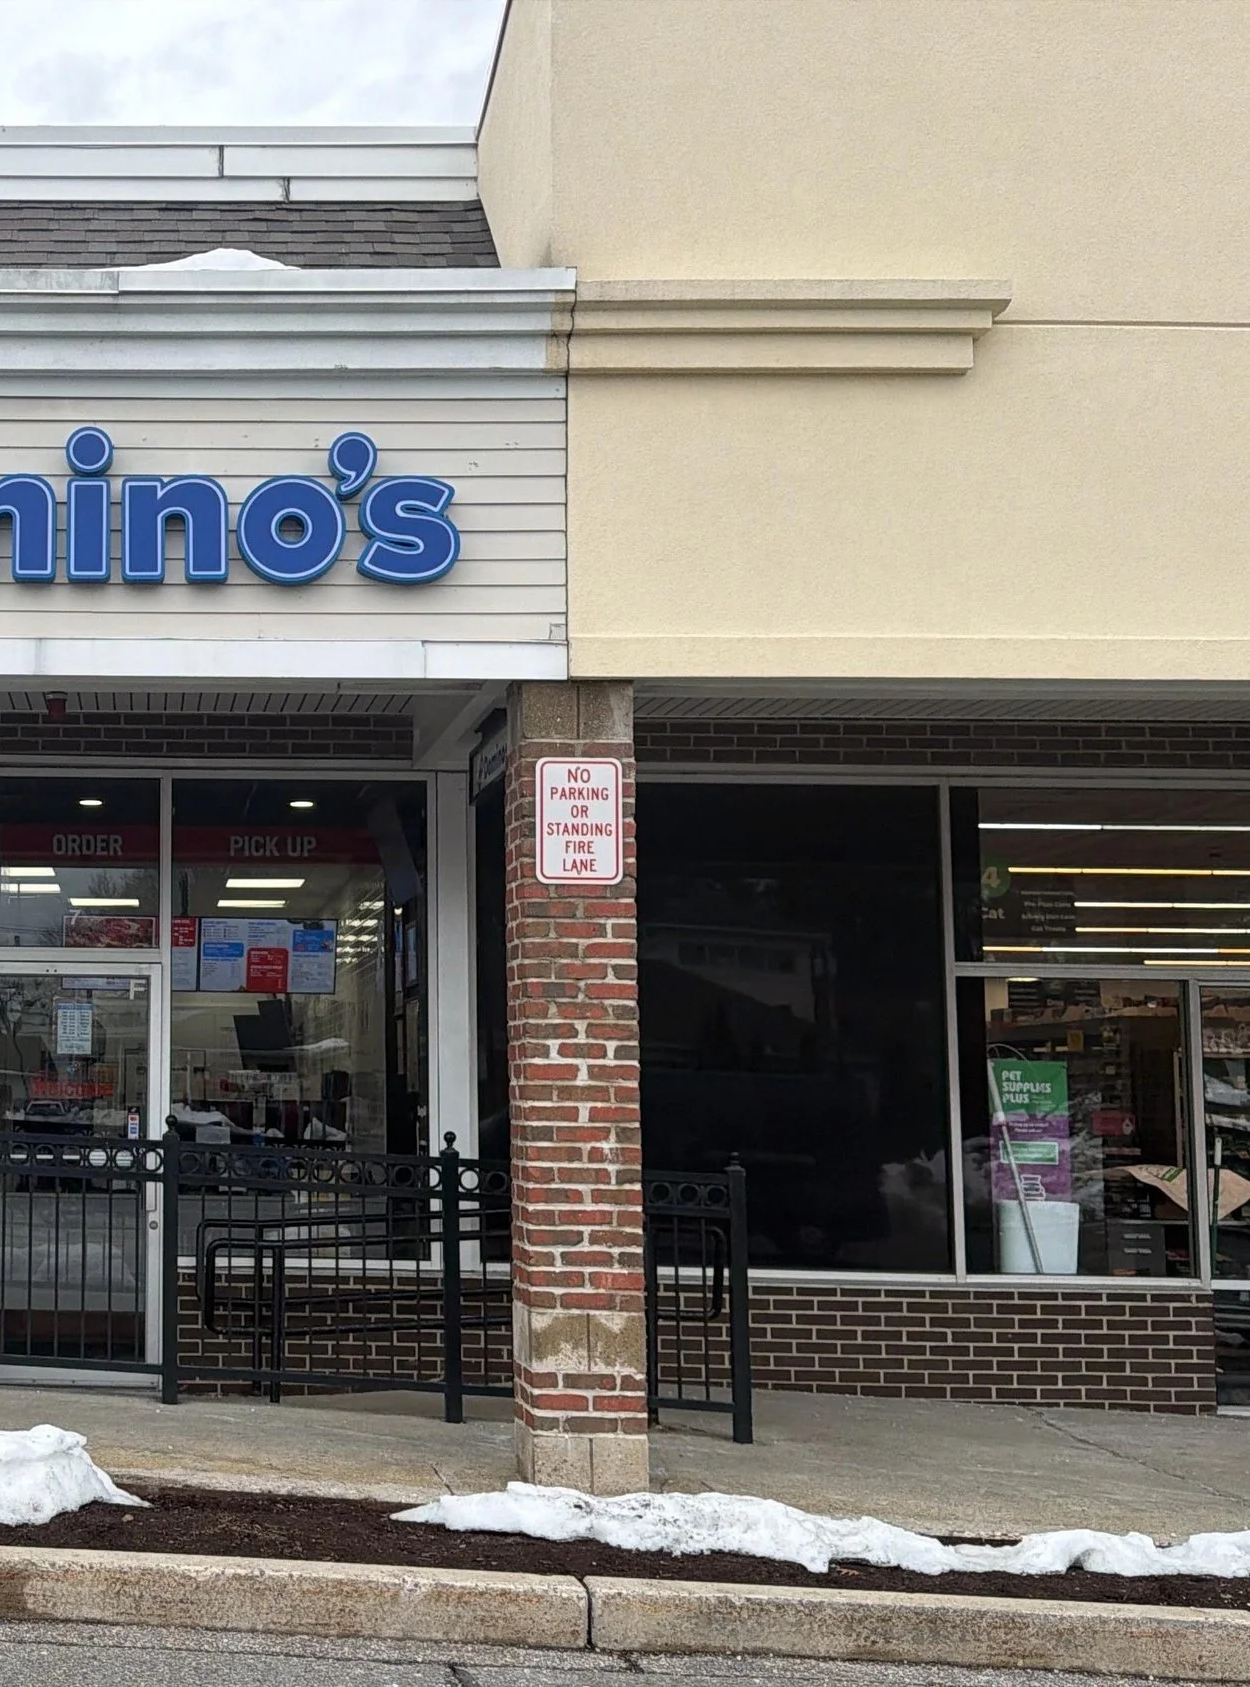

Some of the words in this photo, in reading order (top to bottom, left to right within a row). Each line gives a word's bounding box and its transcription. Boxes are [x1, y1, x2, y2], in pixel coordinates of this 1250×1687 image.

[567, 766, 591, 783] NO
[550, 787, 609, 800] PARKING
[570, 805, 589, 818] OR
[546, 823, 613, 836] STANDING
[52, 834, 123, 856] ORDER
[229, 836, 279, 857] PICK
[288, 837, 317, 857] UP
[565, 841, 595, 854] FIRE
[562, 859, 597, 873] LANE
[981, 866, 1001, 888] 4
[69, 909, 82, 925] 7
[130, 979, 146, 1000] F
[1002, 1071, 1021, 1081] PET
[1002, 1082, 1051, 1093] SUPPLIES
[1003, 1094, 1029, 1103] PLUS
